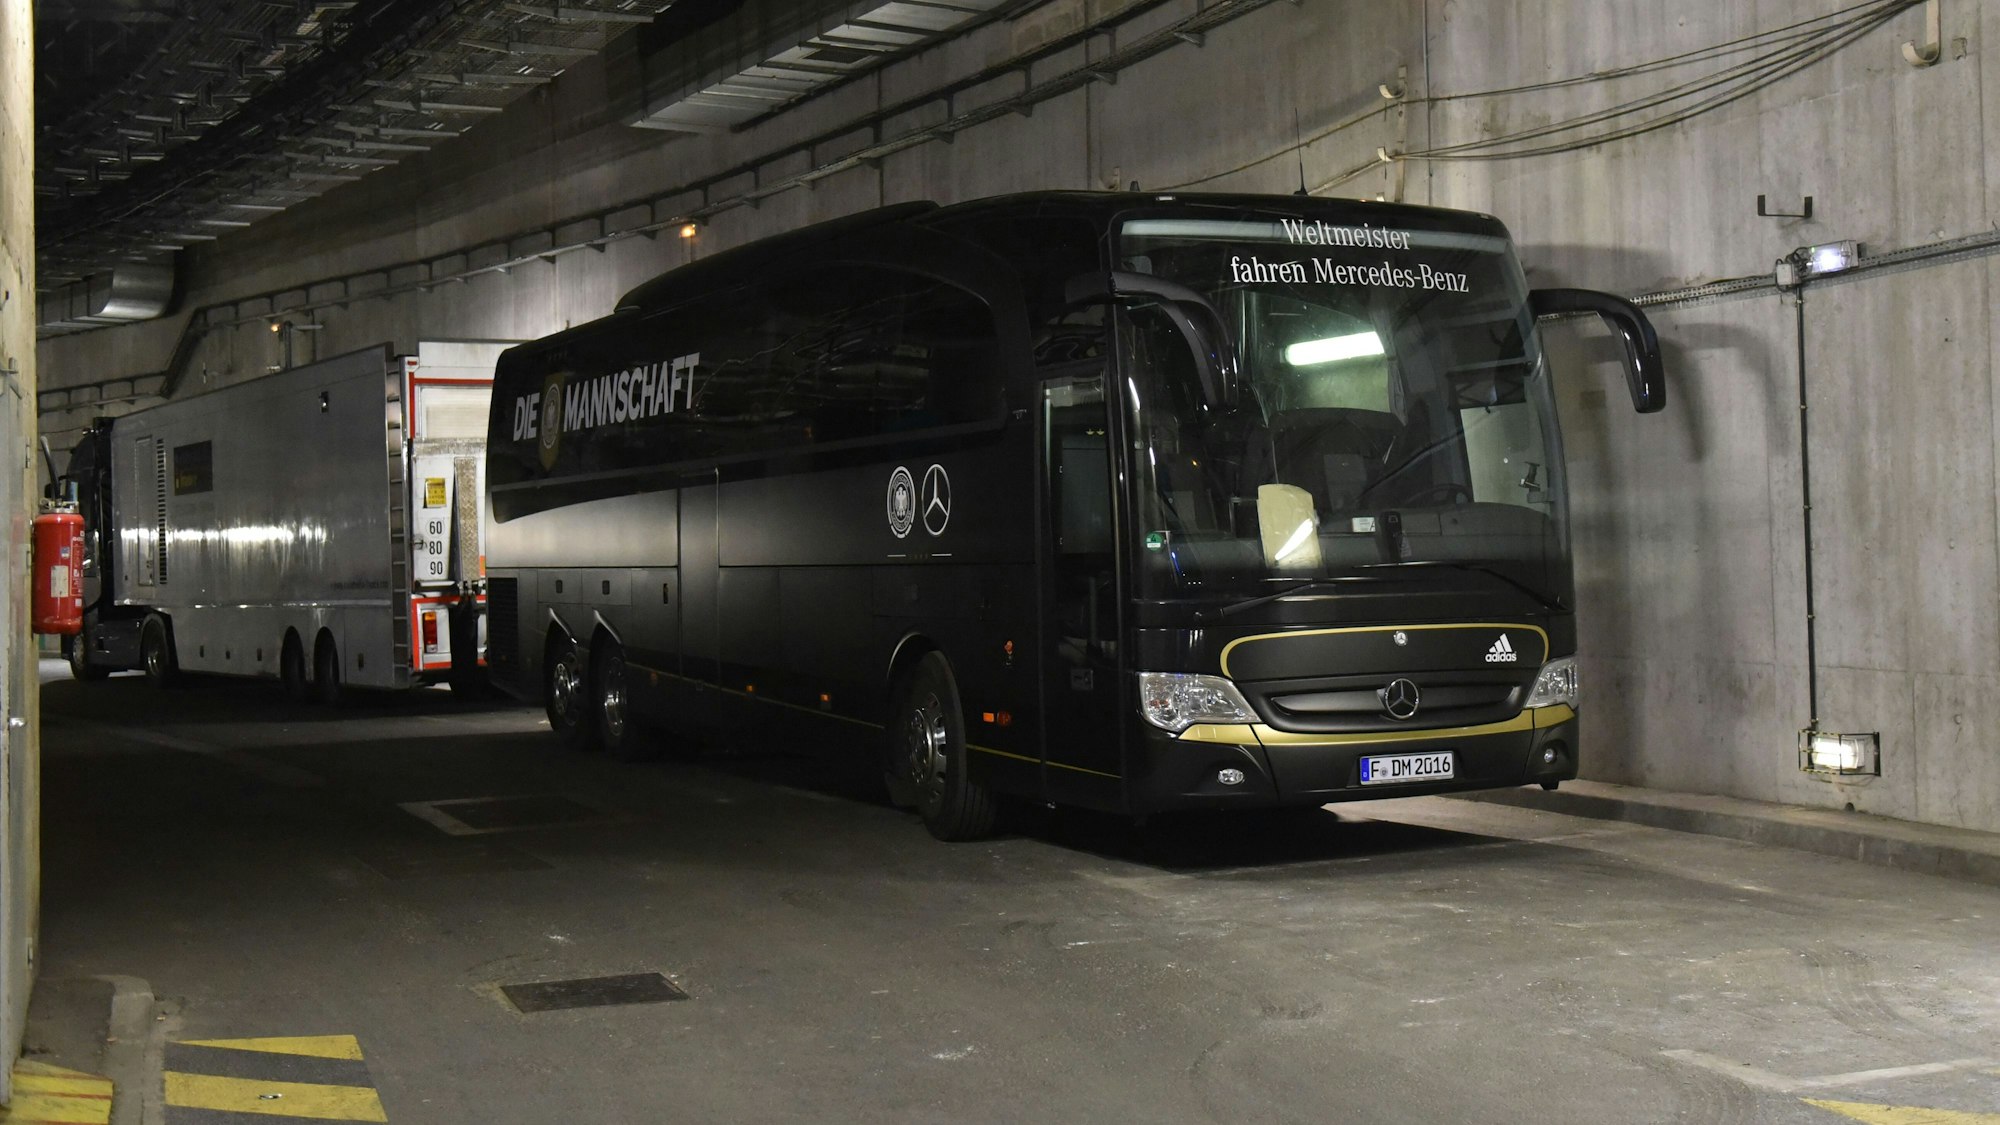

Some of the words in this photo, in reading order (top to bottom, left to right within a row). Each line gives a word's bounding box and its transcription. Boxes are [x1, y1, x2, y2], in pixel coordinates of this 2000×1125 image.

[1281, 218, 1411, 250] Weltmeister
[1230, 256, 1308, 283] fahren
[1312, 257, 1469, 292] Mercedes-Benz
[513, 392, 540, 441] DIE
[563, 352, 700, 432] MANNSCHAFT
[429, 521, 442, 535] 60
[429, 541, 442, 555] 80
[430, 561, 443, 575] 90
[1485, 652, 1517, 662] adidas
[1371, 761, 1380, 778] F
[1392, 759, 1411, 776] DM
[1415, 756, 1451, 774] 2016
